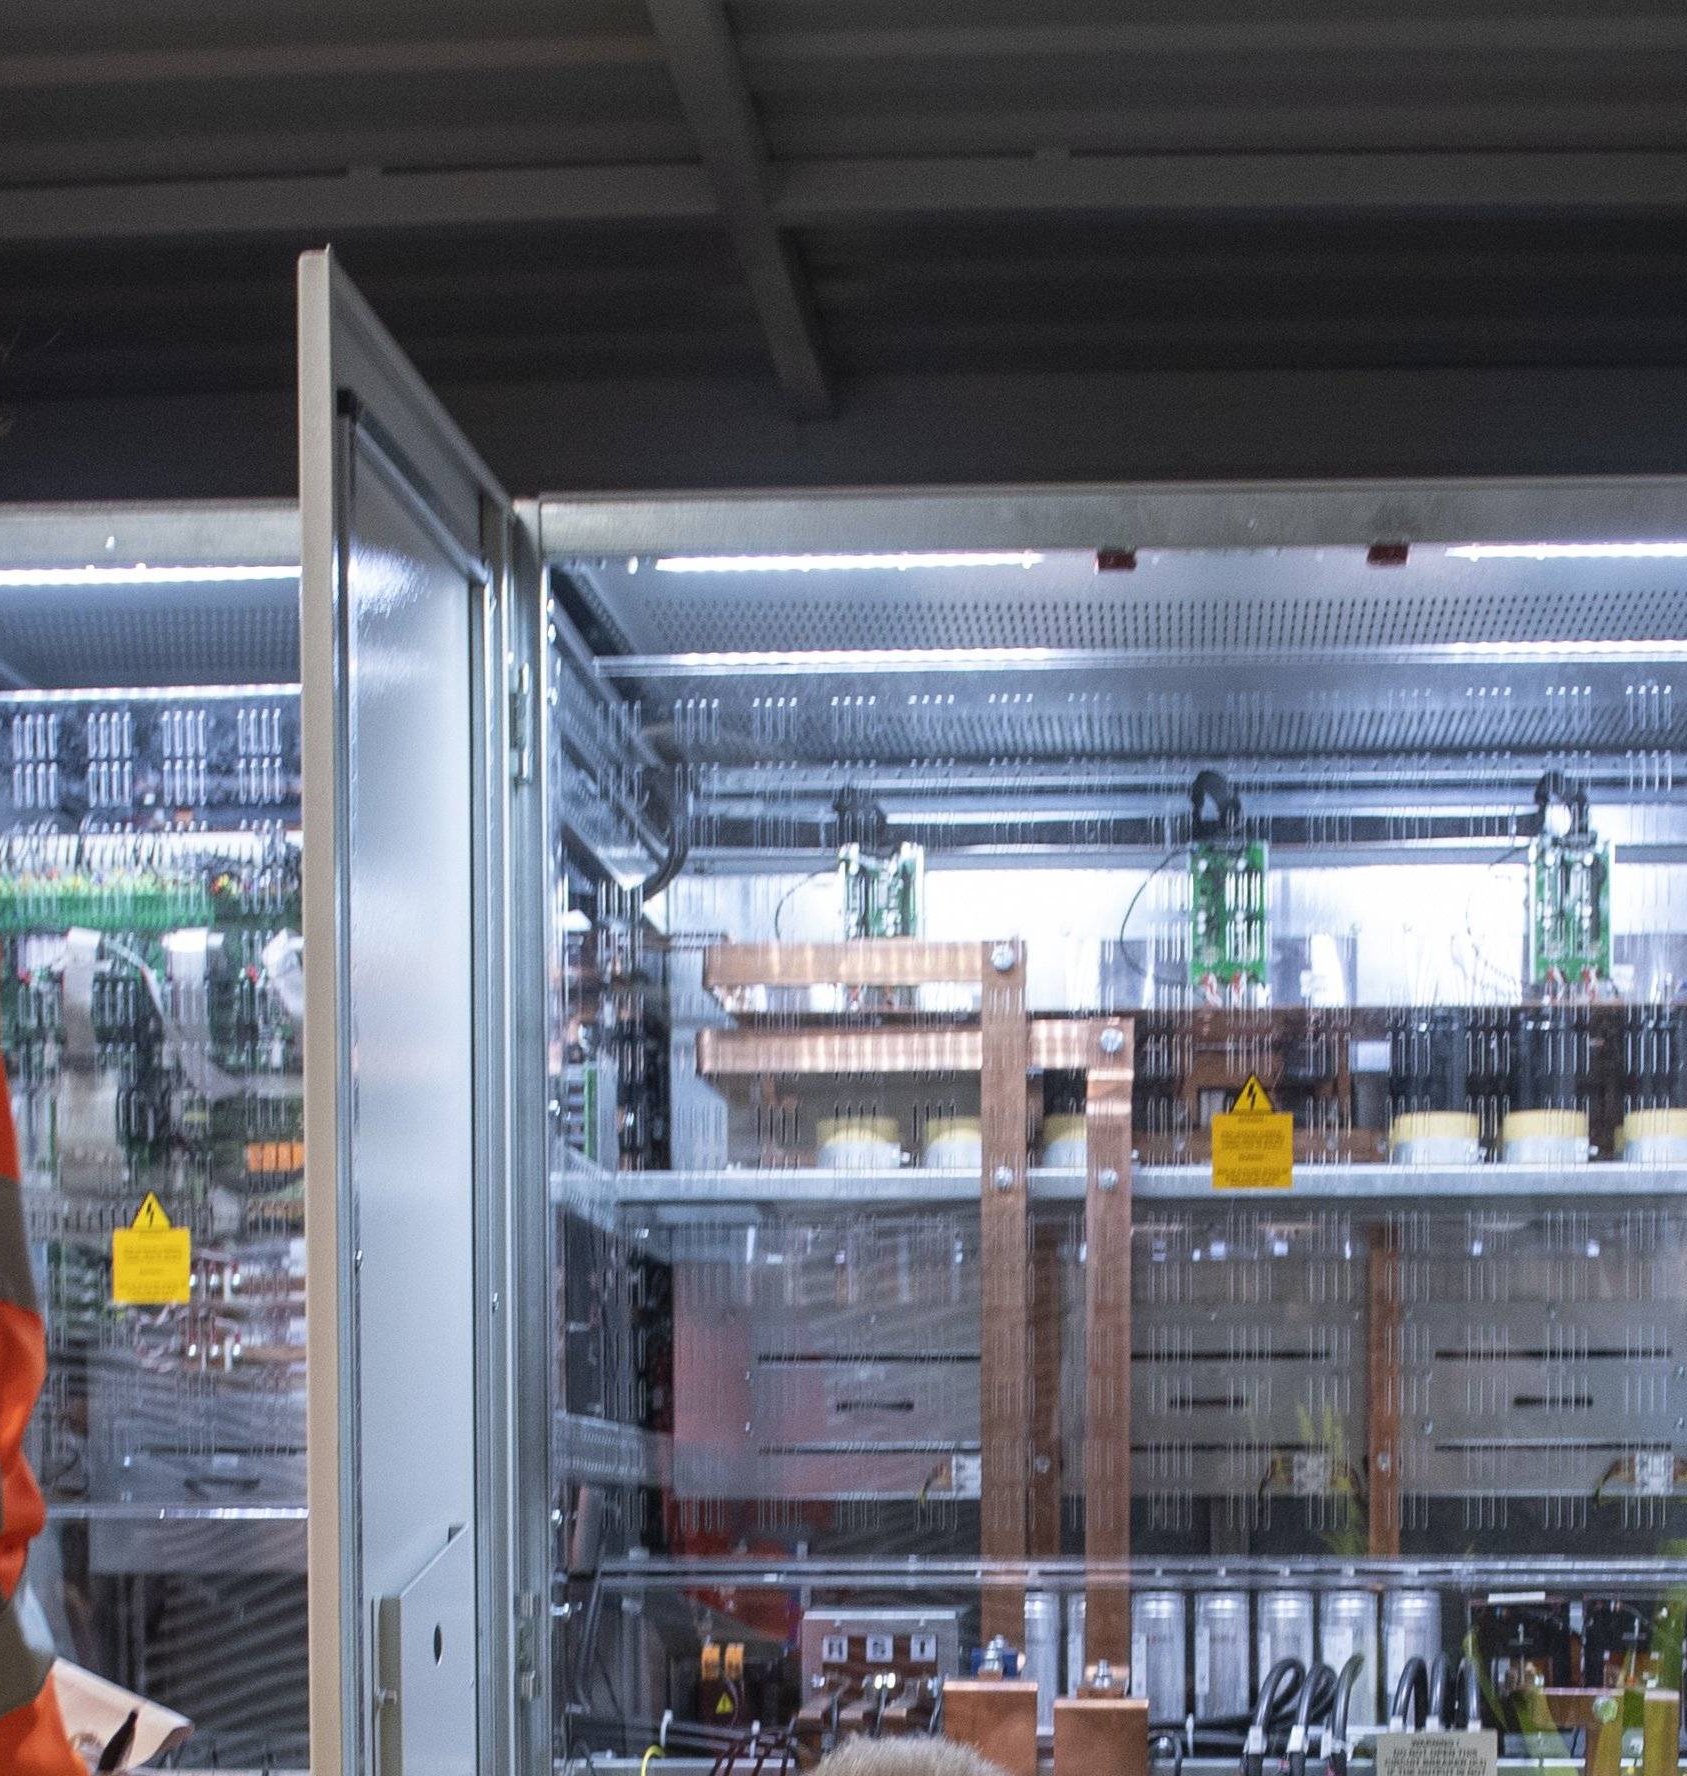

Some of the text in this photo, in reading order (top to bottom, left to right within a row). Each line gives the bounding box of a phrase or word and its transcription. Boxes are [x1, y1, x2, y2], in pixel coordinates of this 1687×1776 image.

[1411, 1738, 1454, 1747] WARNING
[1393, 1748, 1406, 1757] DO
[1409, 1748, 1426, 1757] NOT
[1429, 1748, 1455, 1757] OPEN
[1423, 1758, 1466, 1767] BREAKER
